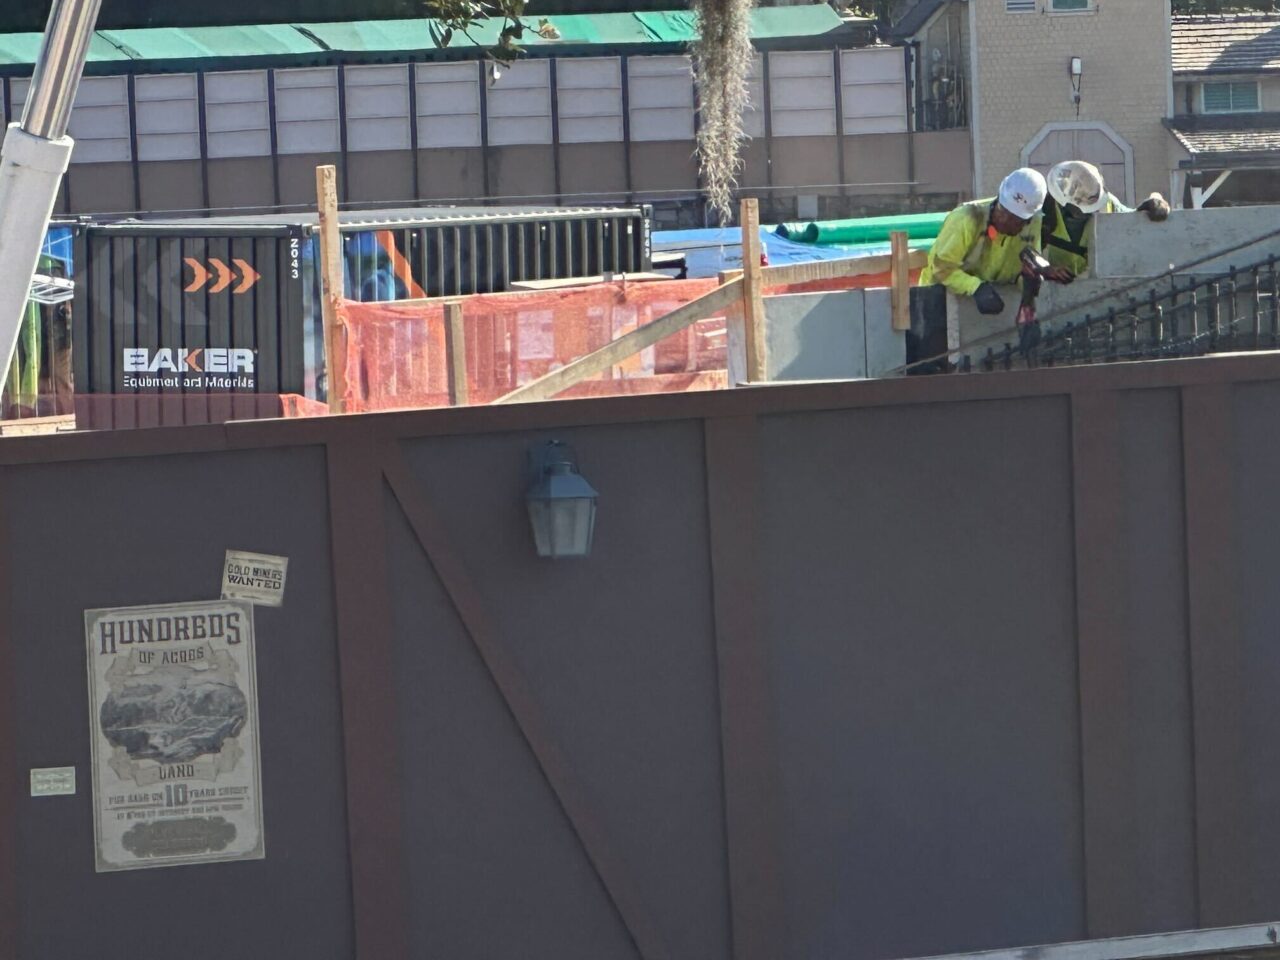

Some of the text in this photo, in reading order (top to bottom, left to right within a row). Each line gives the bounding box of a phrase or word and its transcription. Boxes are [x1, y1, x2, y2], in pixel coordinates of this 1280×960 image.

[123, 347, 255, 372] BAKER
[227, 563, 283, 581] GOLD MINERS
[227, 574, 282, 590] WANTED
[99, 611, 241, 656] HUNDREDS
[139, 650, 155, 664] OF
[159, 763, 195, 780] LAND
[165, 783, 188, 808] 10
